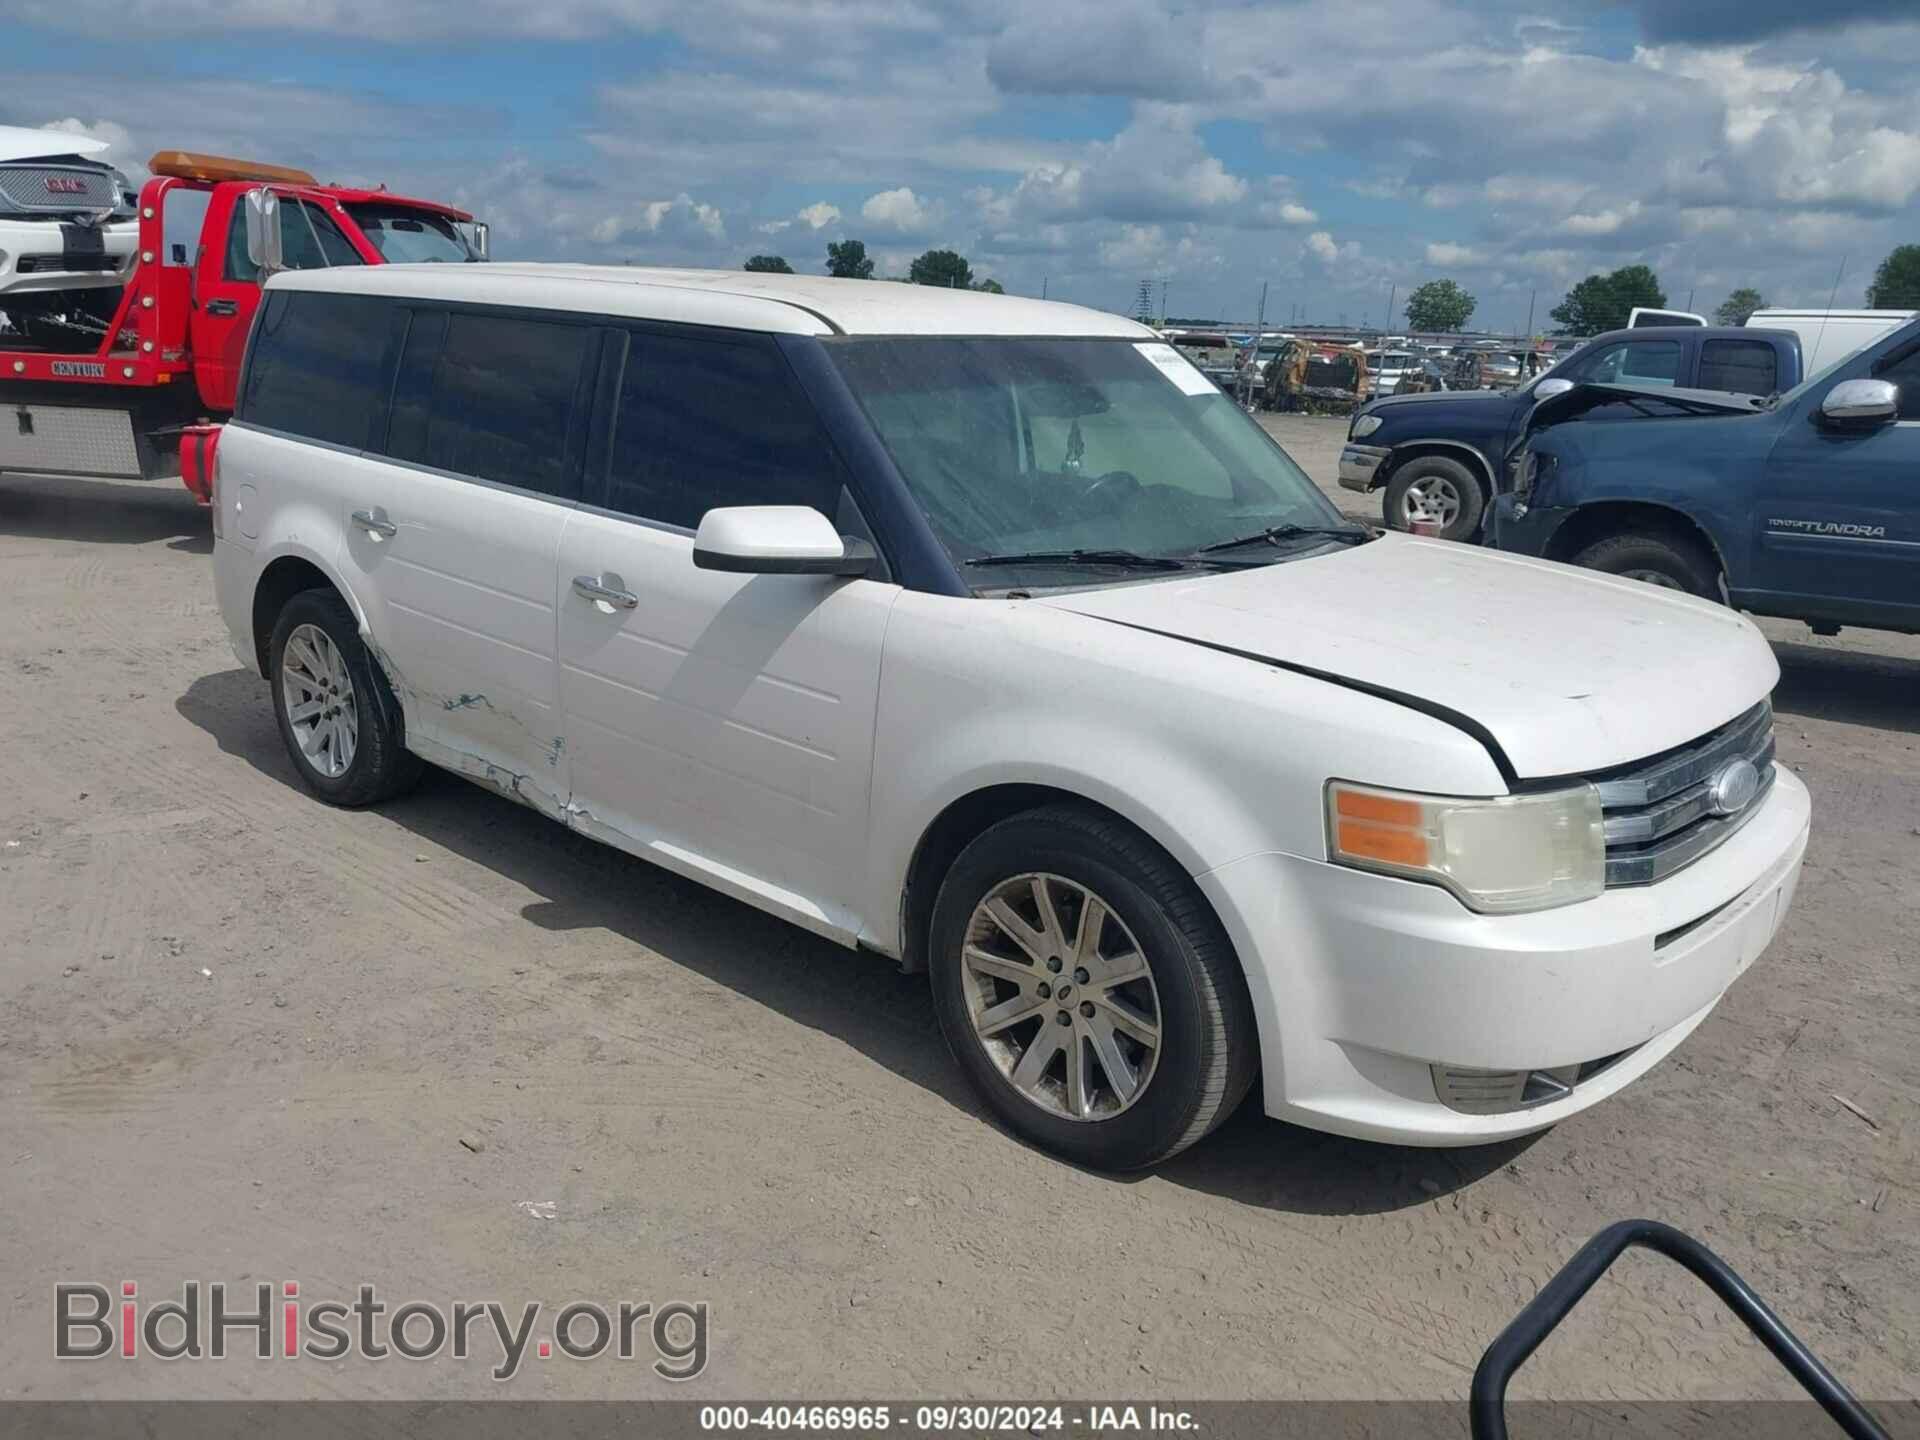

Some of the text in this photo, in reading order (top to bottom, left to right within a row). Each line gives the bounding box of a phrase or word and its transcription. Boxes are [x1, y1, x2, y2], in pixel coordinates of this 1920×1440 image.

[52, 361, 105, 377] CENTURY
[1767, 518, 1886, 537] TOYOTA TUNDRA
